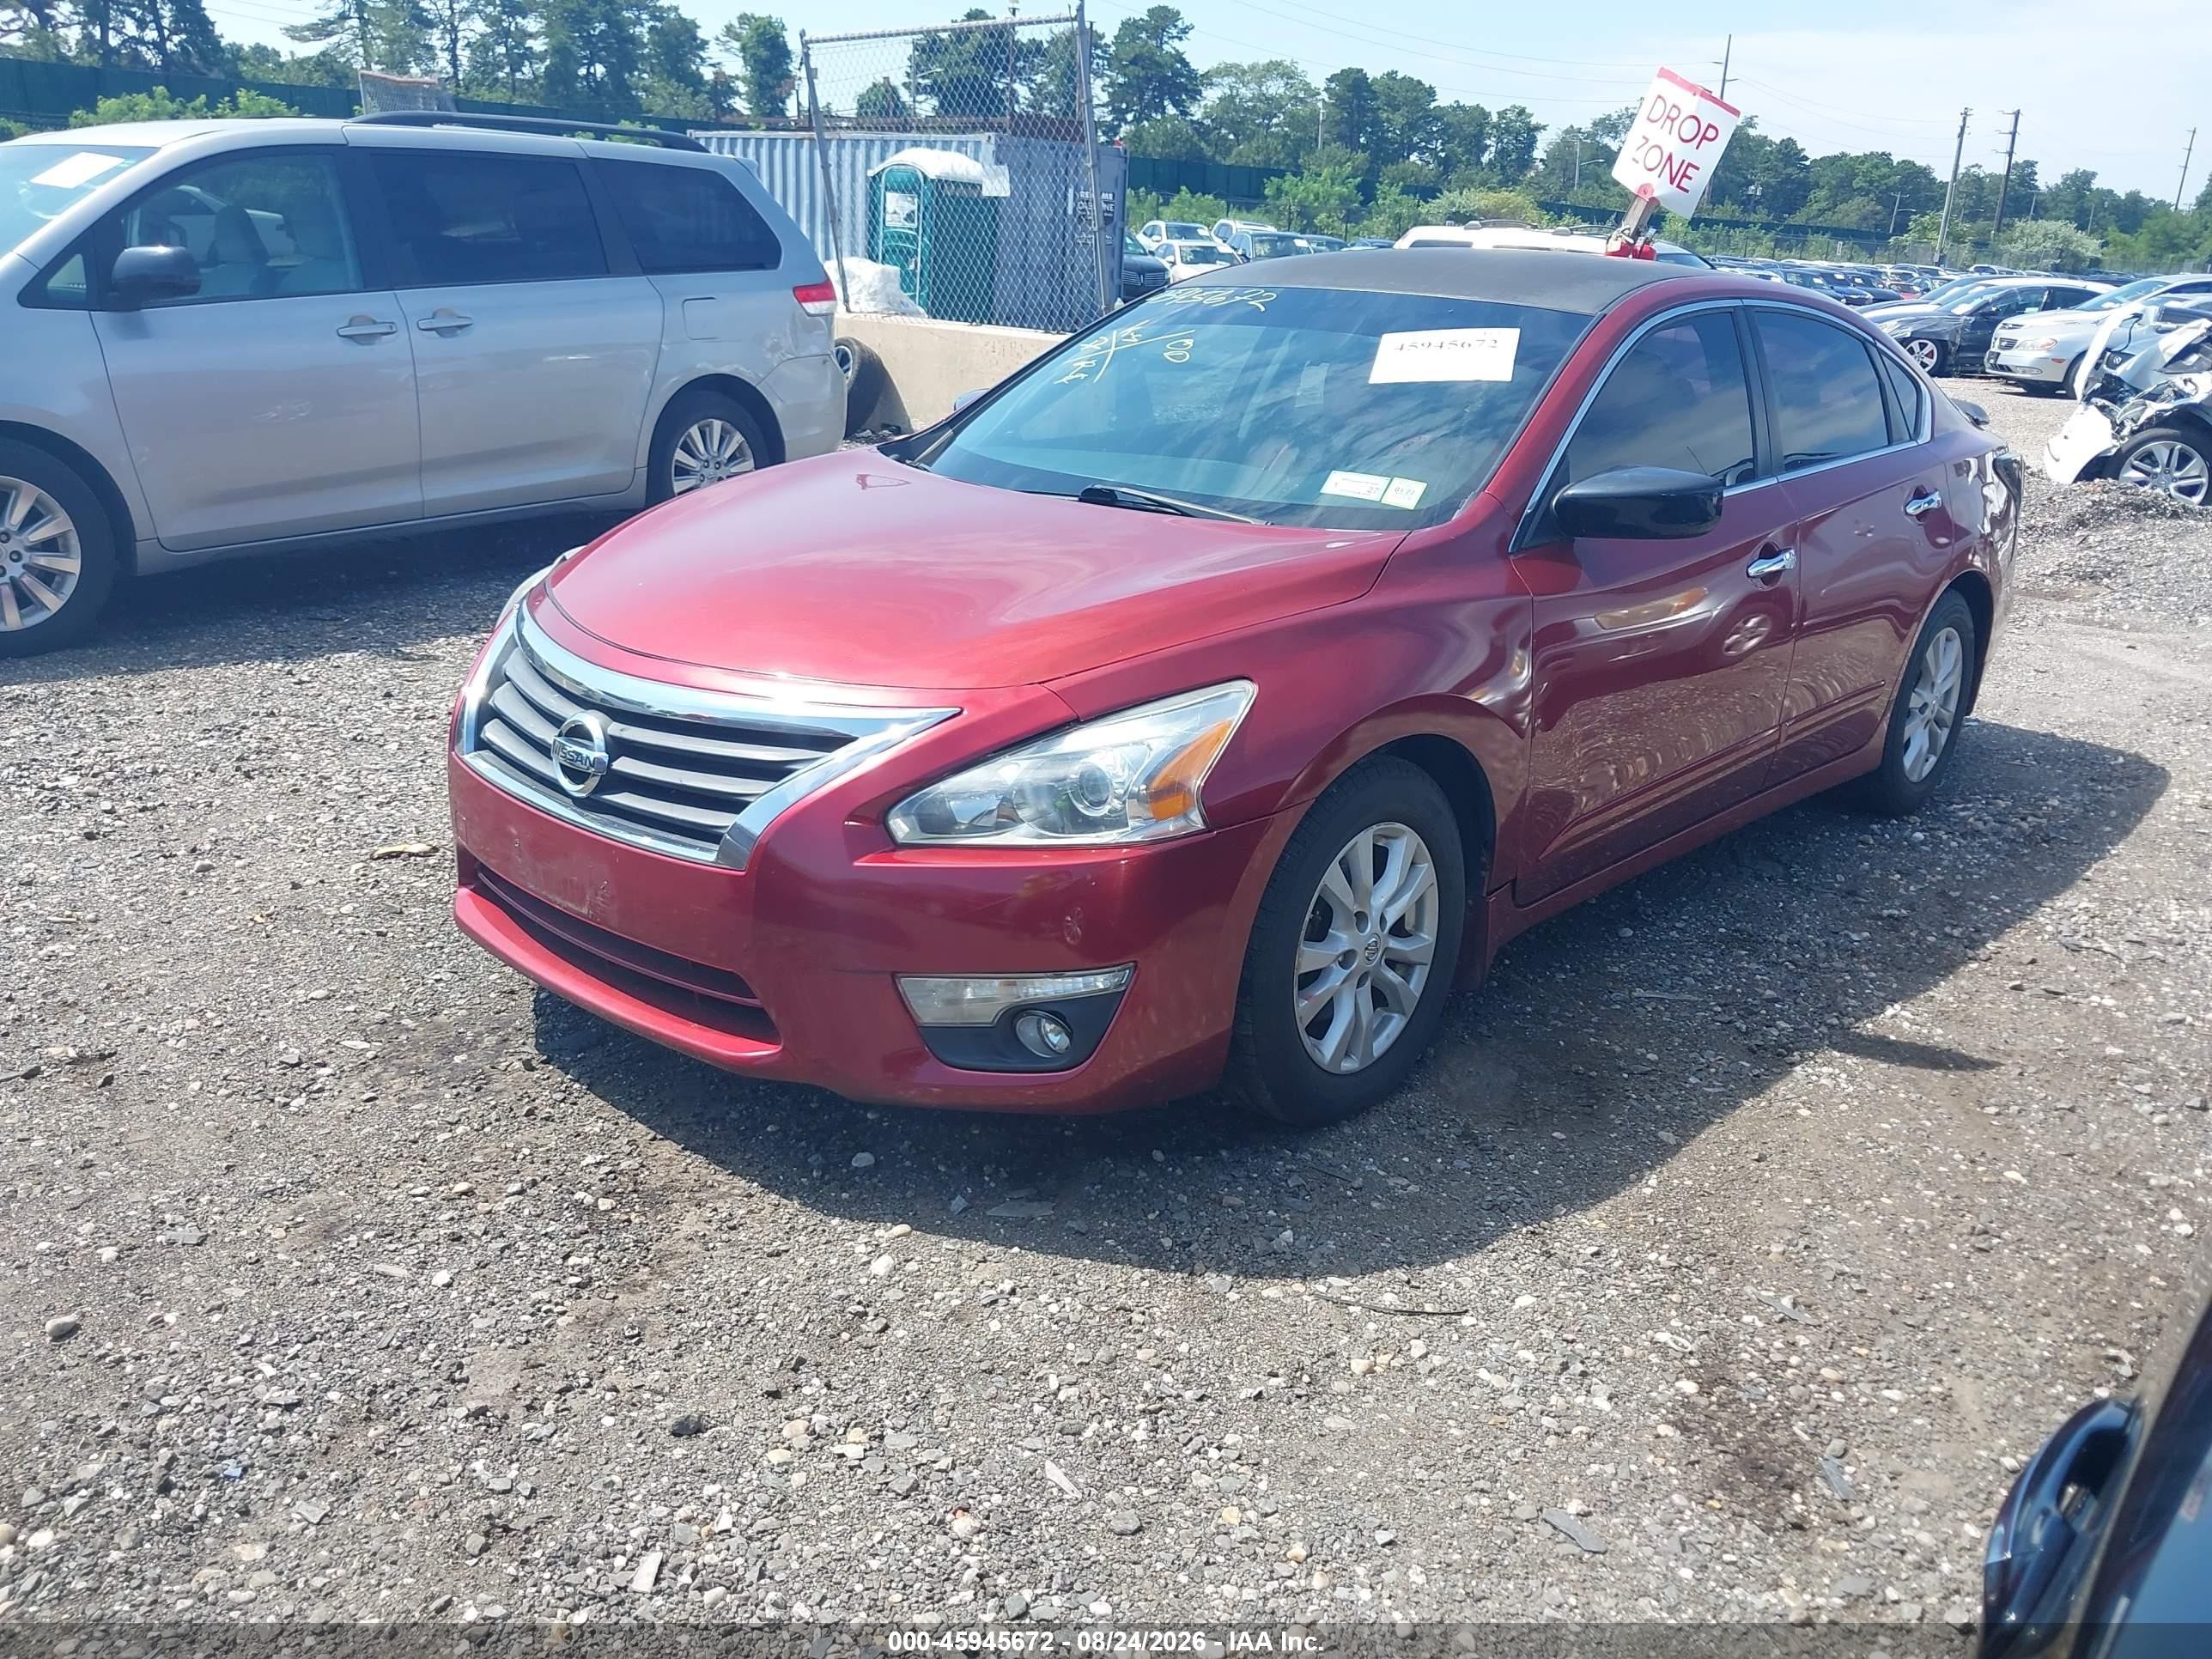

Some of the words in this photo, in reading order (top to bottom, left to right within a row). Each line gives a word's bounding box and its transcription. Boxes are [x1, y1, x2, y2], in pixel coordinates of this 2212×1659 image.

[1647, 94, 1719, 150] DROP
[1632, 135, 1700, 194] ZONE
[1394, 339, 1498, 352] 45945672
[553, 738, 596, 769] NISSAN
